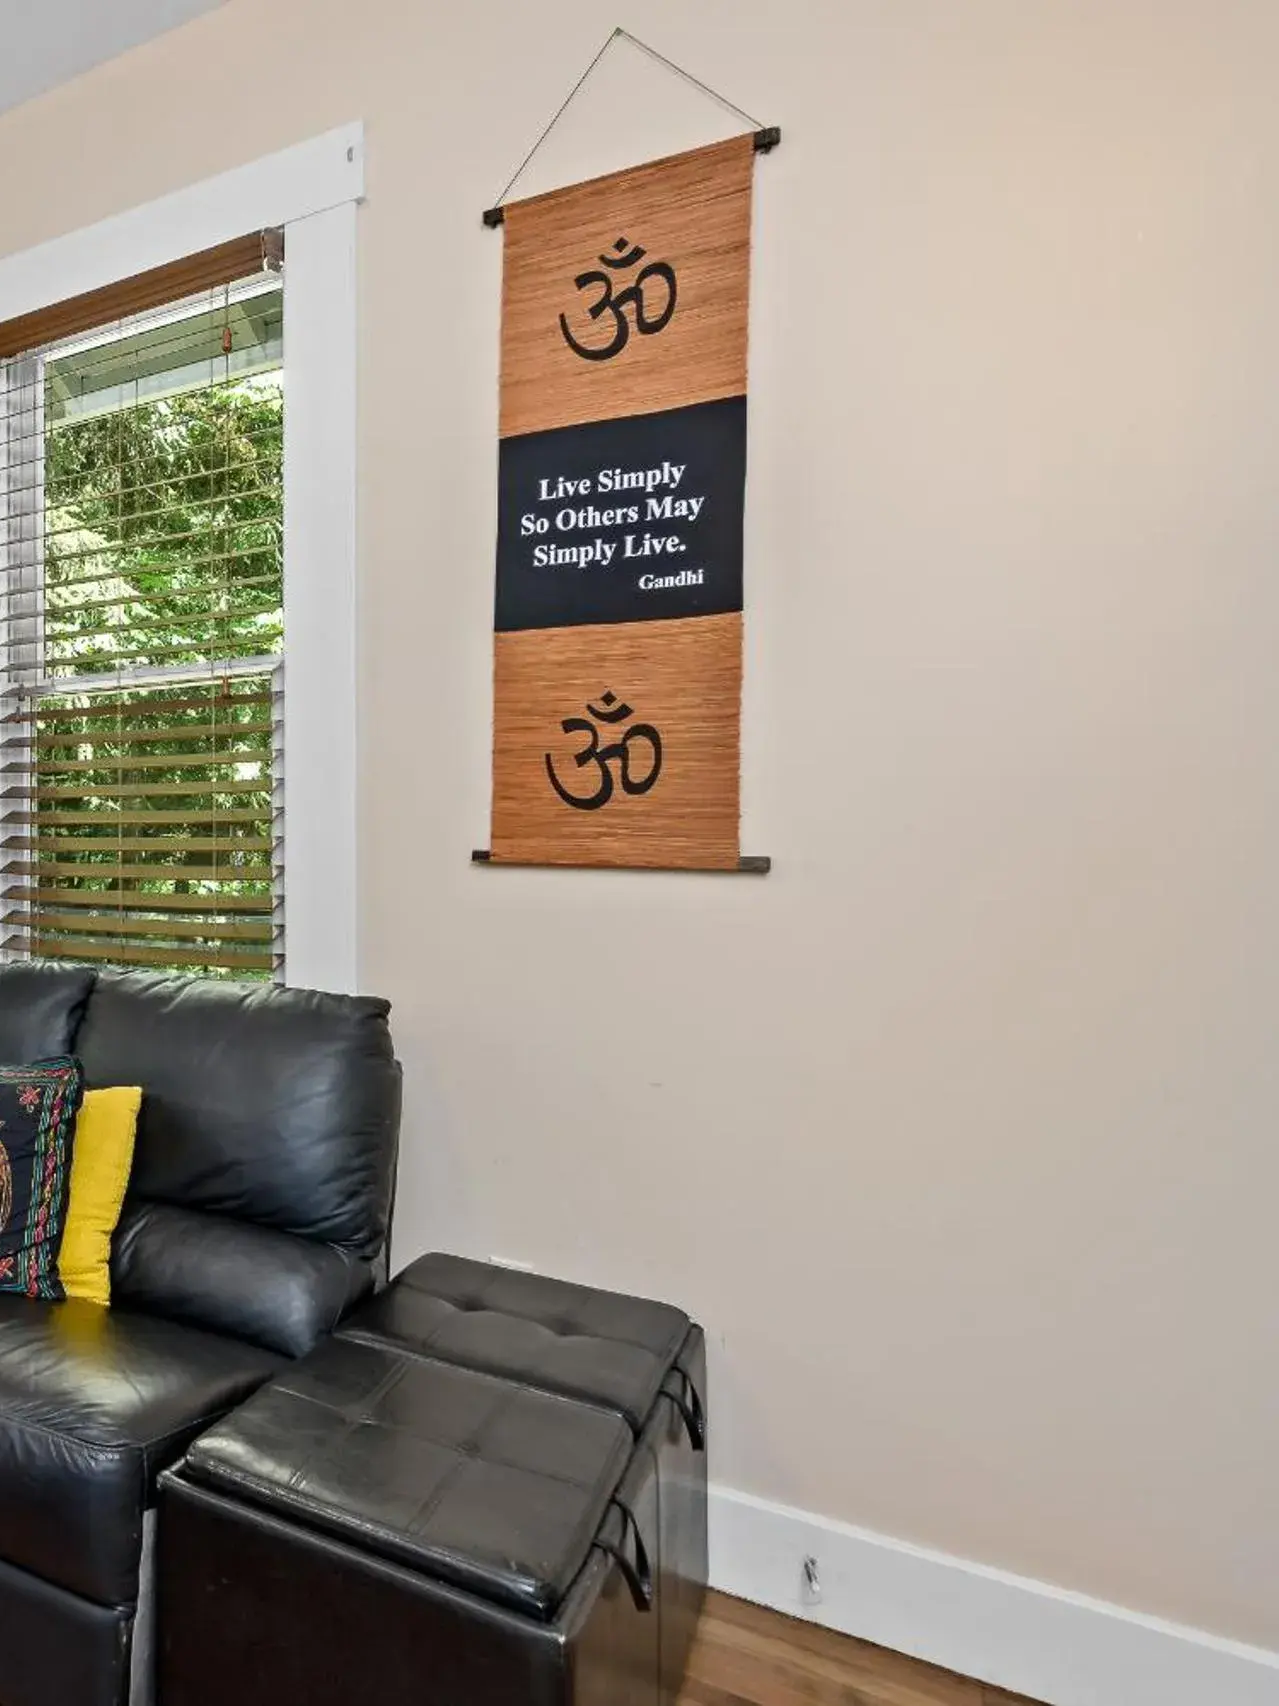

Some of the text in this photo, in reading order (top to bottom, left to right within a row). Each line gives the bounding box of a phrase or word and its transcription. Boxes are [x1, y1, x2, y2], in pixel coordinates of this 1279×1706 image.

[539, 462, 685, 500] Live Simply
[521, 496, 704, 536] So Others May
[533, 533, 686, 568] Simply Live.
[639, 569, 704, 589] Gandhi
